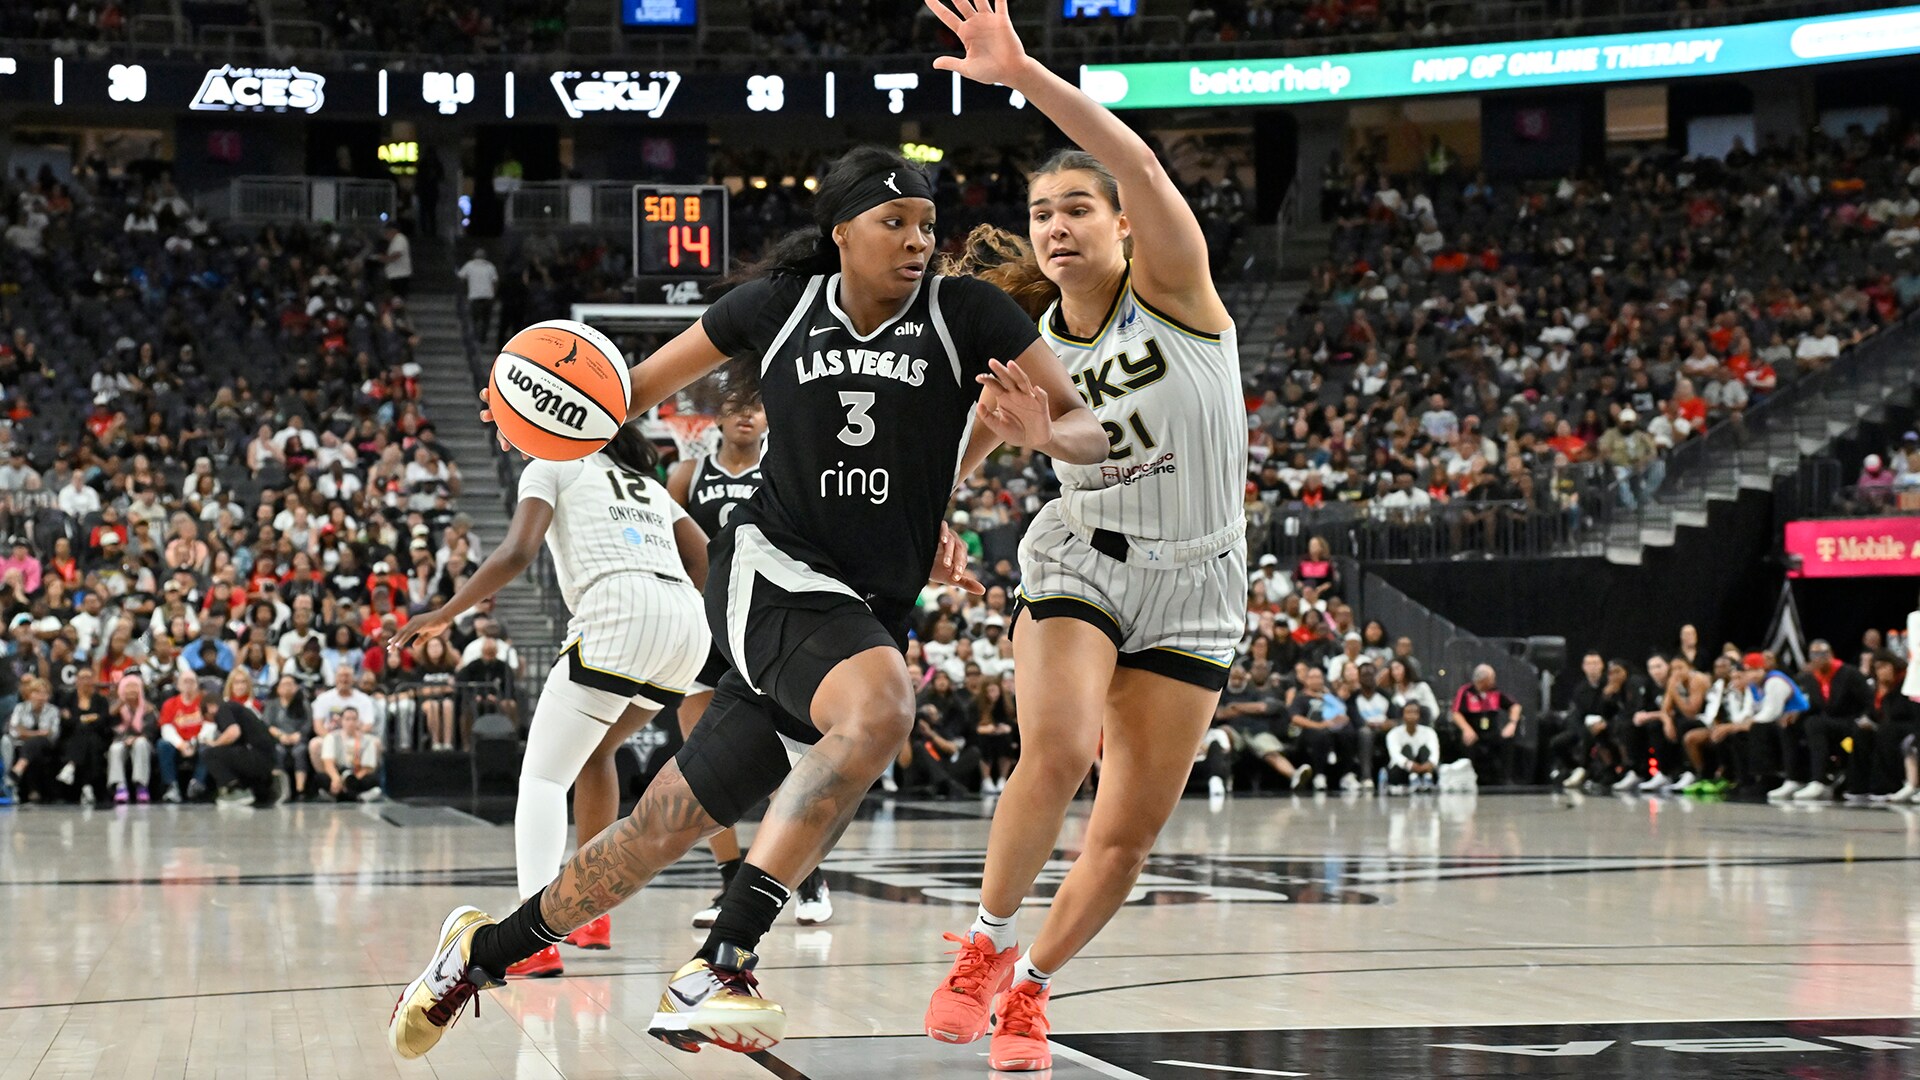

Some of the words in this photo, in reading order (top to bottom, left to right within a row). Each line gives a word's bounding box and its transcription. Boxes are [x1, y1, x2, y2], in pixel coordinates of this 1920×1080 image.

[1190, 61, 1351, 95] betterhelp
[1411, 56, 1469, 83] MVP
[1469, 54, 1507, 80] OF
[1507, 47, 1600, 77] ONLINE
[1602, 38, 1724, 69] THERAPY
[202, 76, 317, 108] ACES
[572, 82, 660, 111] SKY
[668, 225, 710, 268] 14
[894, 322, 924, 337] ally
[795, 350, 845, 384] LAS
[847, 349, 929, 387] VEGAS
[507, 364, 588, 431] Wilson
[836, 391, 876, 446] 3
[1099, 407, 1158, 460] 21
[606, 469, 650, 505] 12
[697, 484, 725, 505] LAS
[725, 484, 760, 500] VEG
[820, 460, 889, 505] ring
[644, 533, 672, 550] AT&T
[1837, 535, 1906, 562] Mobile
